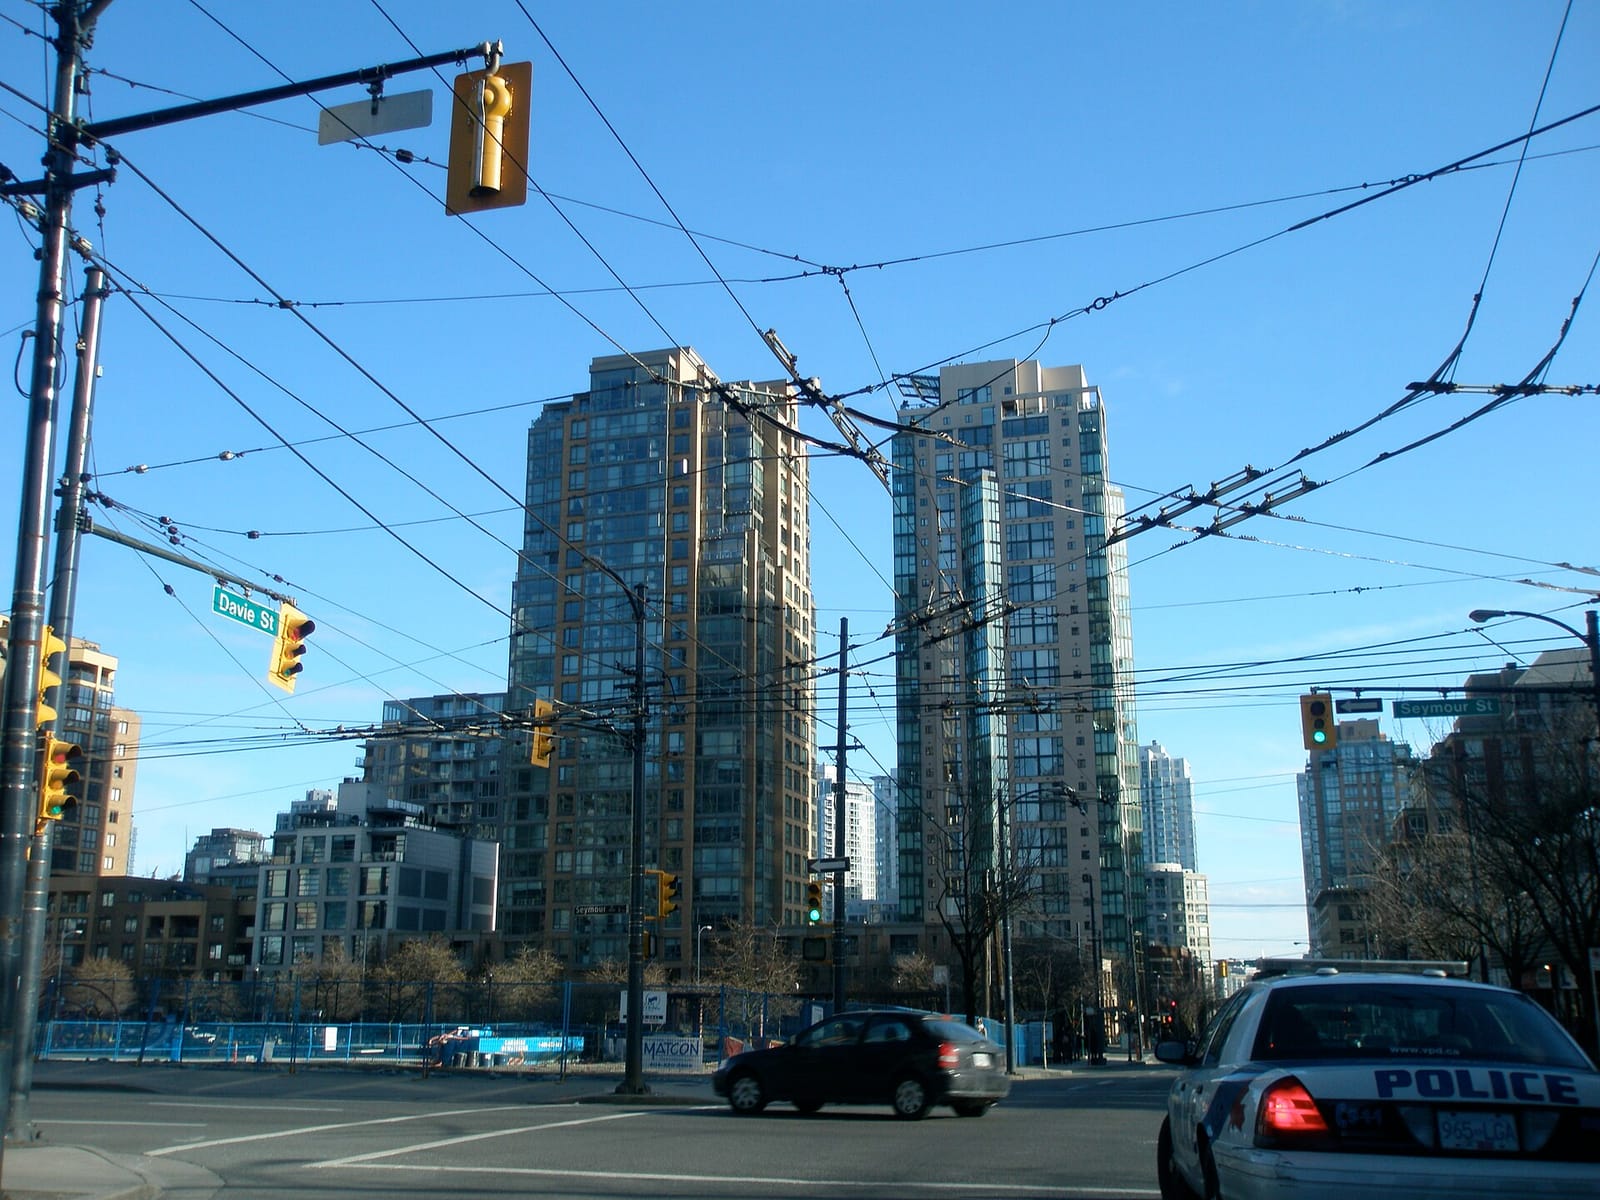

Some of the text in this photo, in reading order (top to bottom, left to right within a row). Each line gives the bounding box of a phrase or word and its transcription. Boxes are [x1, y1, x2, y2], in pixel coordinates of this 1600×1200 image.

[219, 592, 275, 631] Davie St
[1401, 699, 1494, 716] Seymour St
[575, 905, 606, 915] Seymour
[644, 1040, 699, 1060] MATCON
[1374, 1068, 1581, 1105] POLICE
